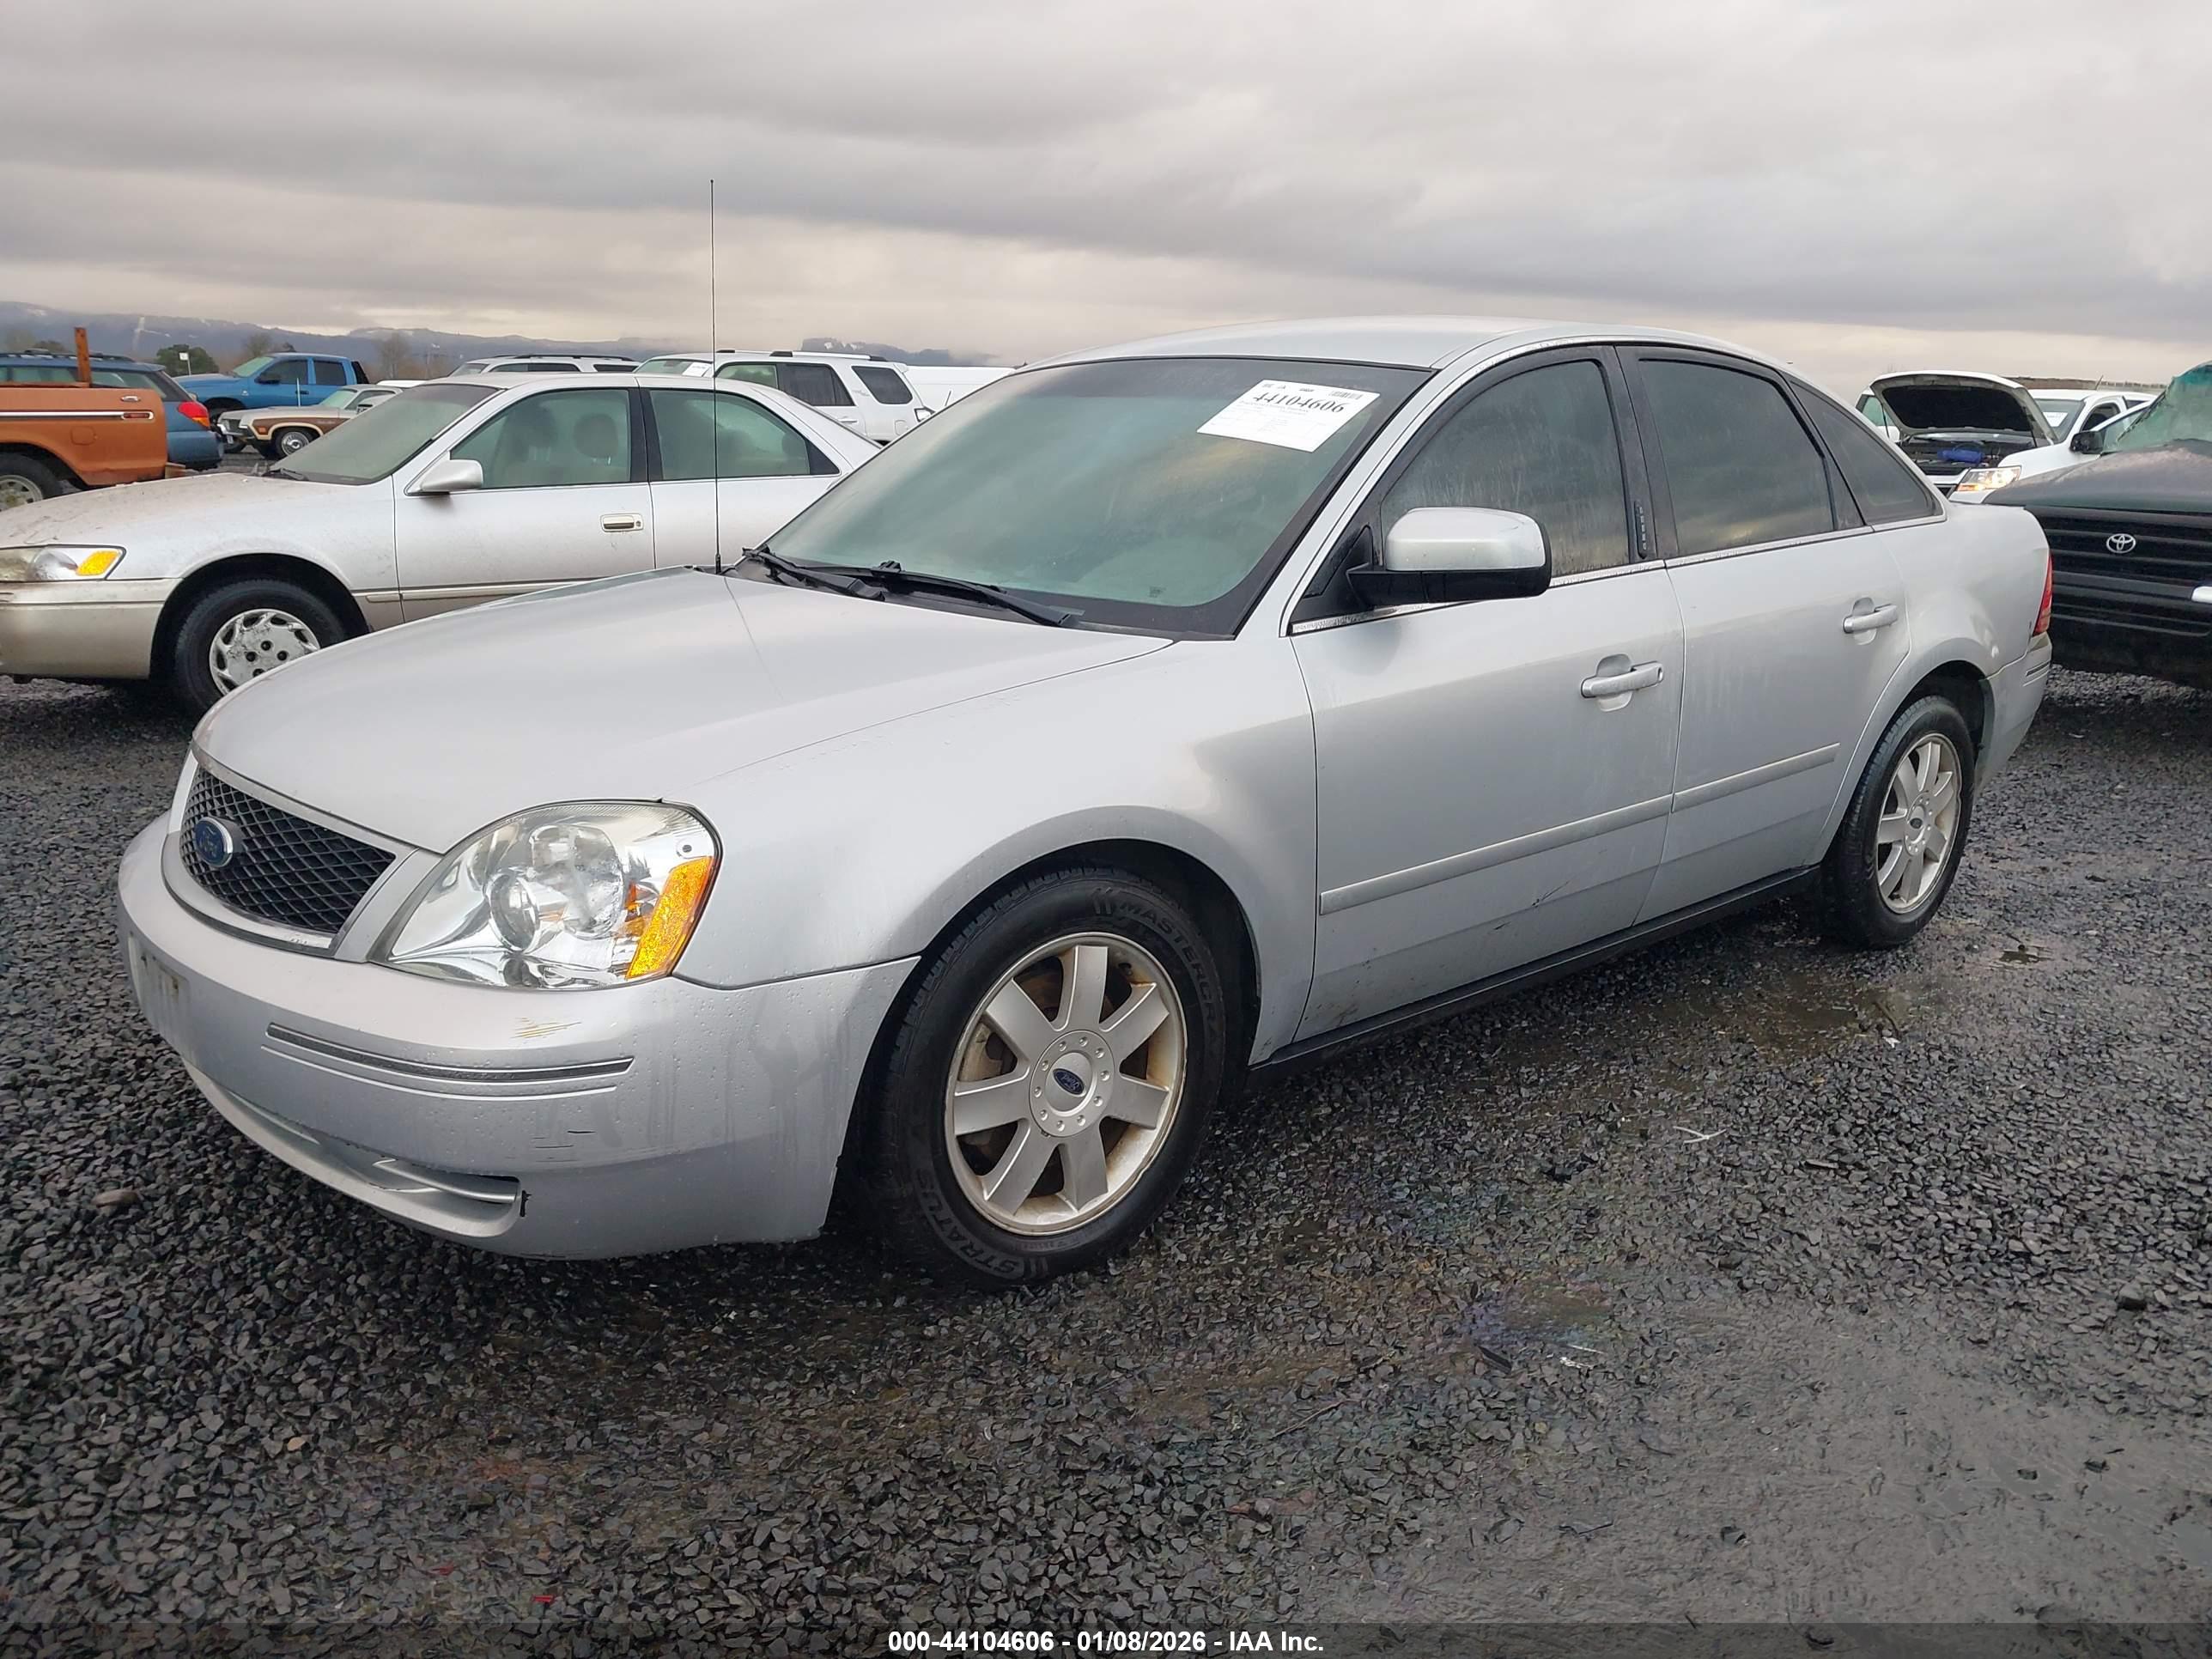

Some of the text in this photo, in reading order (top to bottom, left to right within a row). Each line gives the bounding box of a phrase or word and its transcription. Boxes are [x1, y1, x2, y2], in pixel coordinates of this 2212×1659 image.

[1252, 392, 1346, 414] 44104606
[1118, 901, 1219, 1065] MASTERCR
[913, 1167, 1019, 1274] STRATUS
